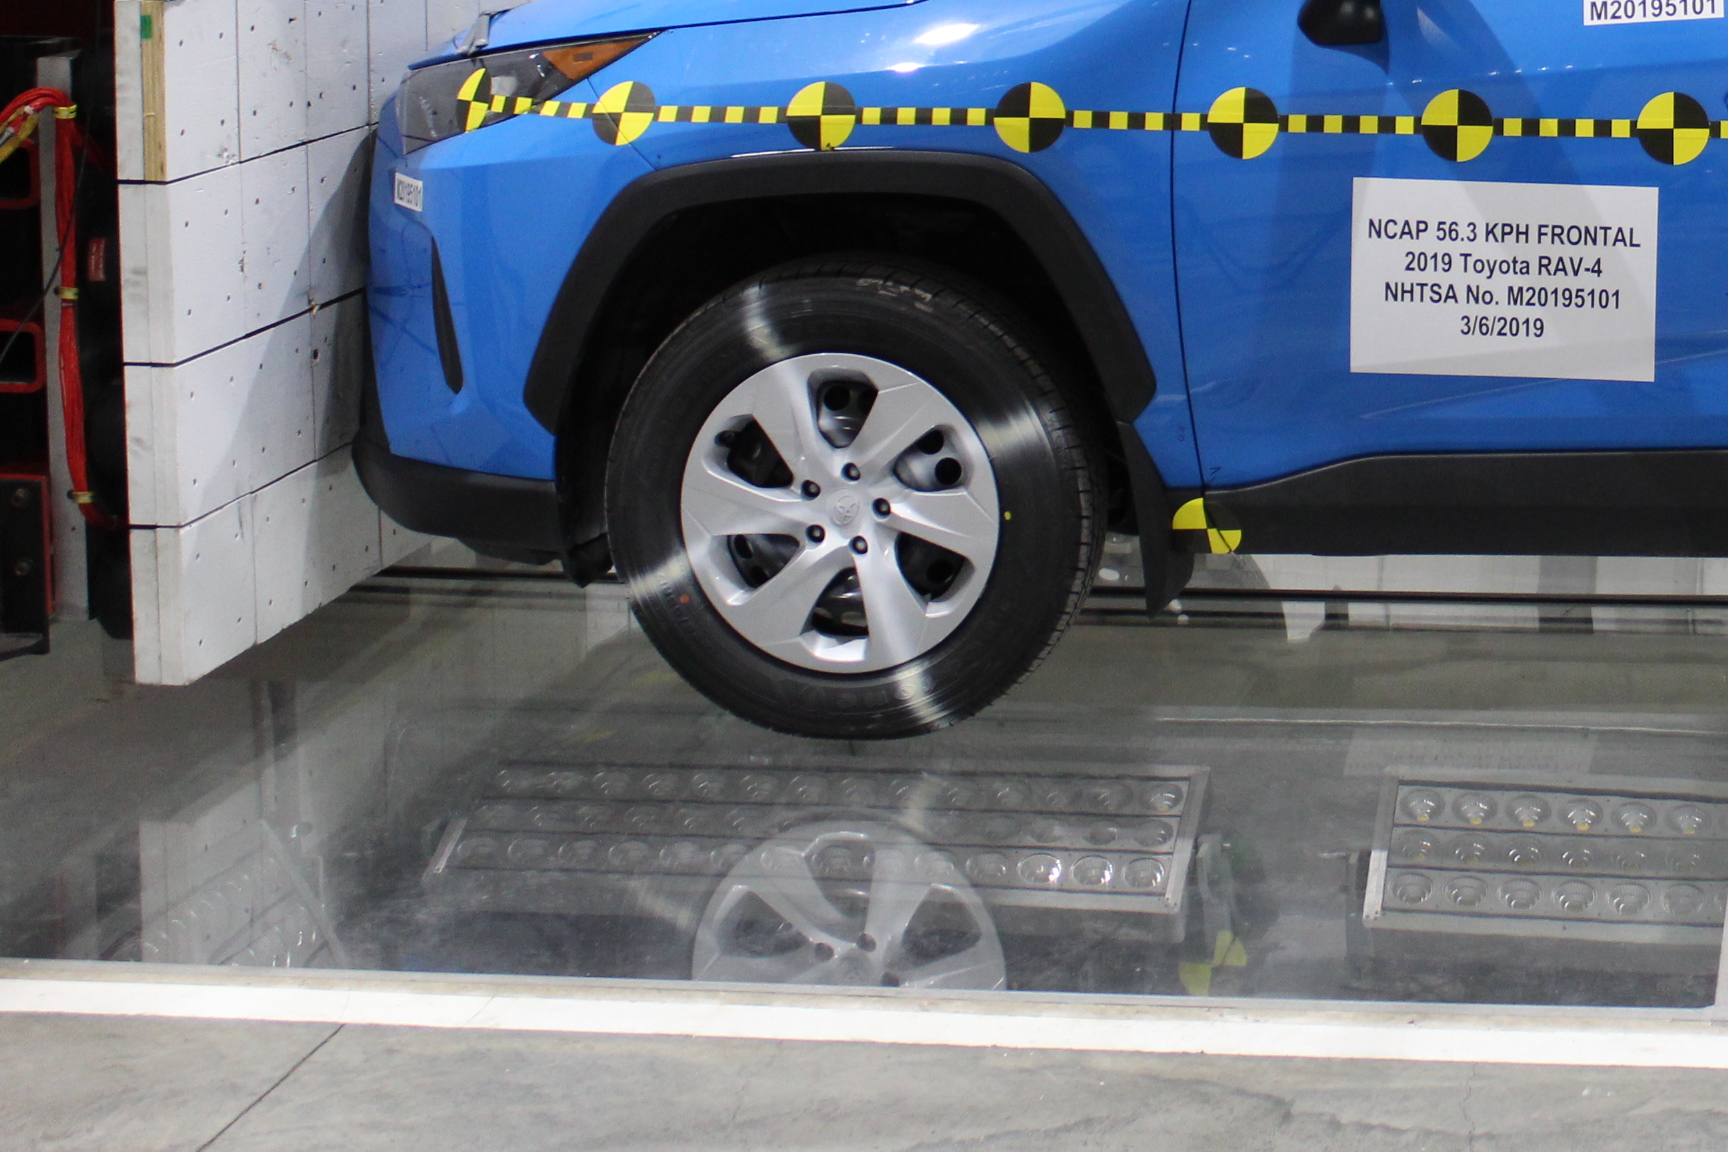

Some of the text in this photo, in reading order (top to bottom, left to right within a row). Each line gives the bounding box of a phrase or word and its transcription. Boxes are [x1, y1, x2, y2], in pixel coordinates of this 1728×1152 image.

[1368, 218, 1641, 247] NCAP 56.3 KPH FRONTAL
[1404, 251, 1602, 279] 2019 Toyota RAV-4
[1384, 282, 1620, 309] NHTSA No. M20195101
[1460, 316, 1544, 338] 3/6/2019
